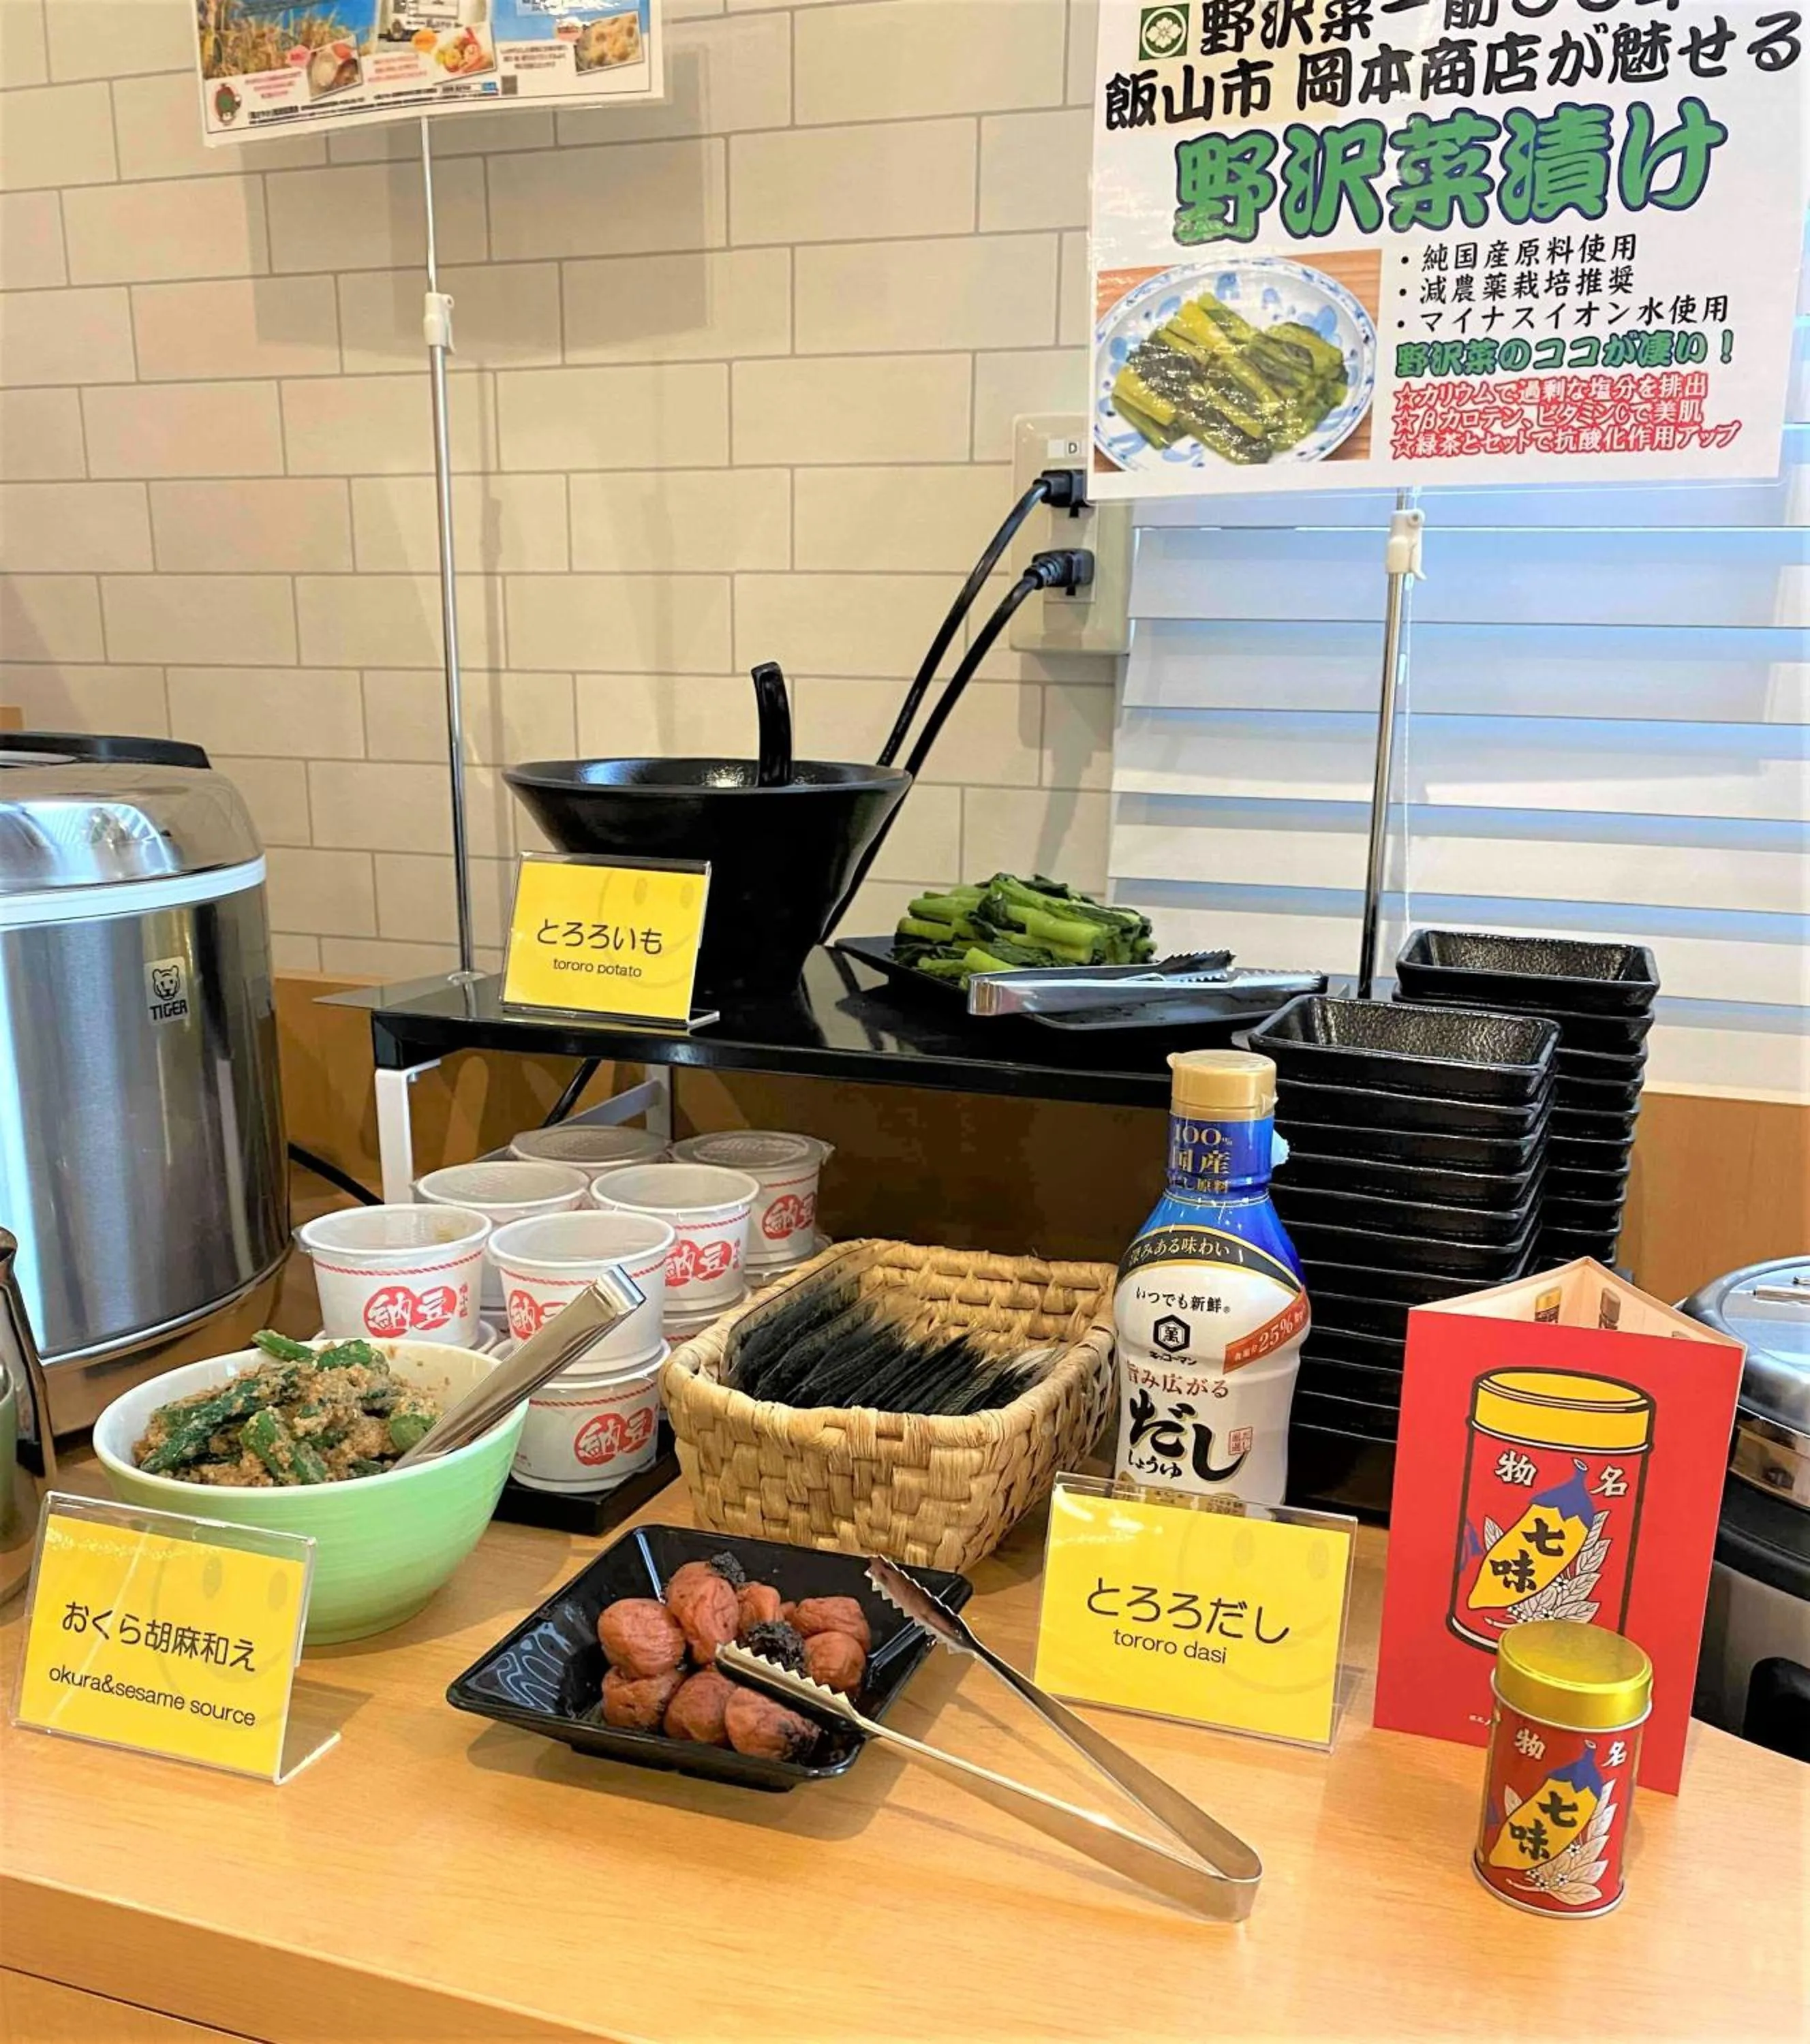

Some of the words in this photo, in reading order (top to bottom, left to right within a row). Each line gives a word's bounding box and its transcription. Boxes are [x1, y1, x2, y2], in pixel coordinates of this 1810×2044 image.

[1103, 59, 1274, 129] 飯山市
[1297, 10, 1803, 110] 岡本商店が魅せる
[1171, 96, 1728, 245] 野沢菜漬け
[1422, 234, 1637, 272] 純国産原料使用
[1420, 267, 1635, 305] 減農薬栽培推奨
[1420, 295, 1729, 332] マイナスイオン水使用
[537, 918, 662, 955] とろろいも
[553, 958, 594, 973] tororo
[597, 962, 642, 978] potato
[149, 999, 188, 1021] TIGER
[365, 1288, 455, 1333] 納豆
[578, 1410, 652, 1461] 納豆
[1130, 1389, 1248, 1481] だし
[1128, 1449, 1182, 1479] しょうゆ
[1494, 1450, 1537, 1487] 物
[1589, 1465, 1629, 1497] 名
[1489, 1517, 1565, 1594] 七味
[1087, 1577, 1289, 1644] とろろだし
[62, 1602, 256, 1672] おくら胡麻和え
[1113, 1629, 1178, 1656] tororo
[1184, 1641, 1227, 1664] dasi
[49, 1664, 185, 1710] okura&sesame
[189, 1699, 256, 1726] source
[1513, 1728, 1546, 1760] 物
[1601, 1741, 1628, 1767] 名
[1509, 1790, 1579, 1861] 七味
